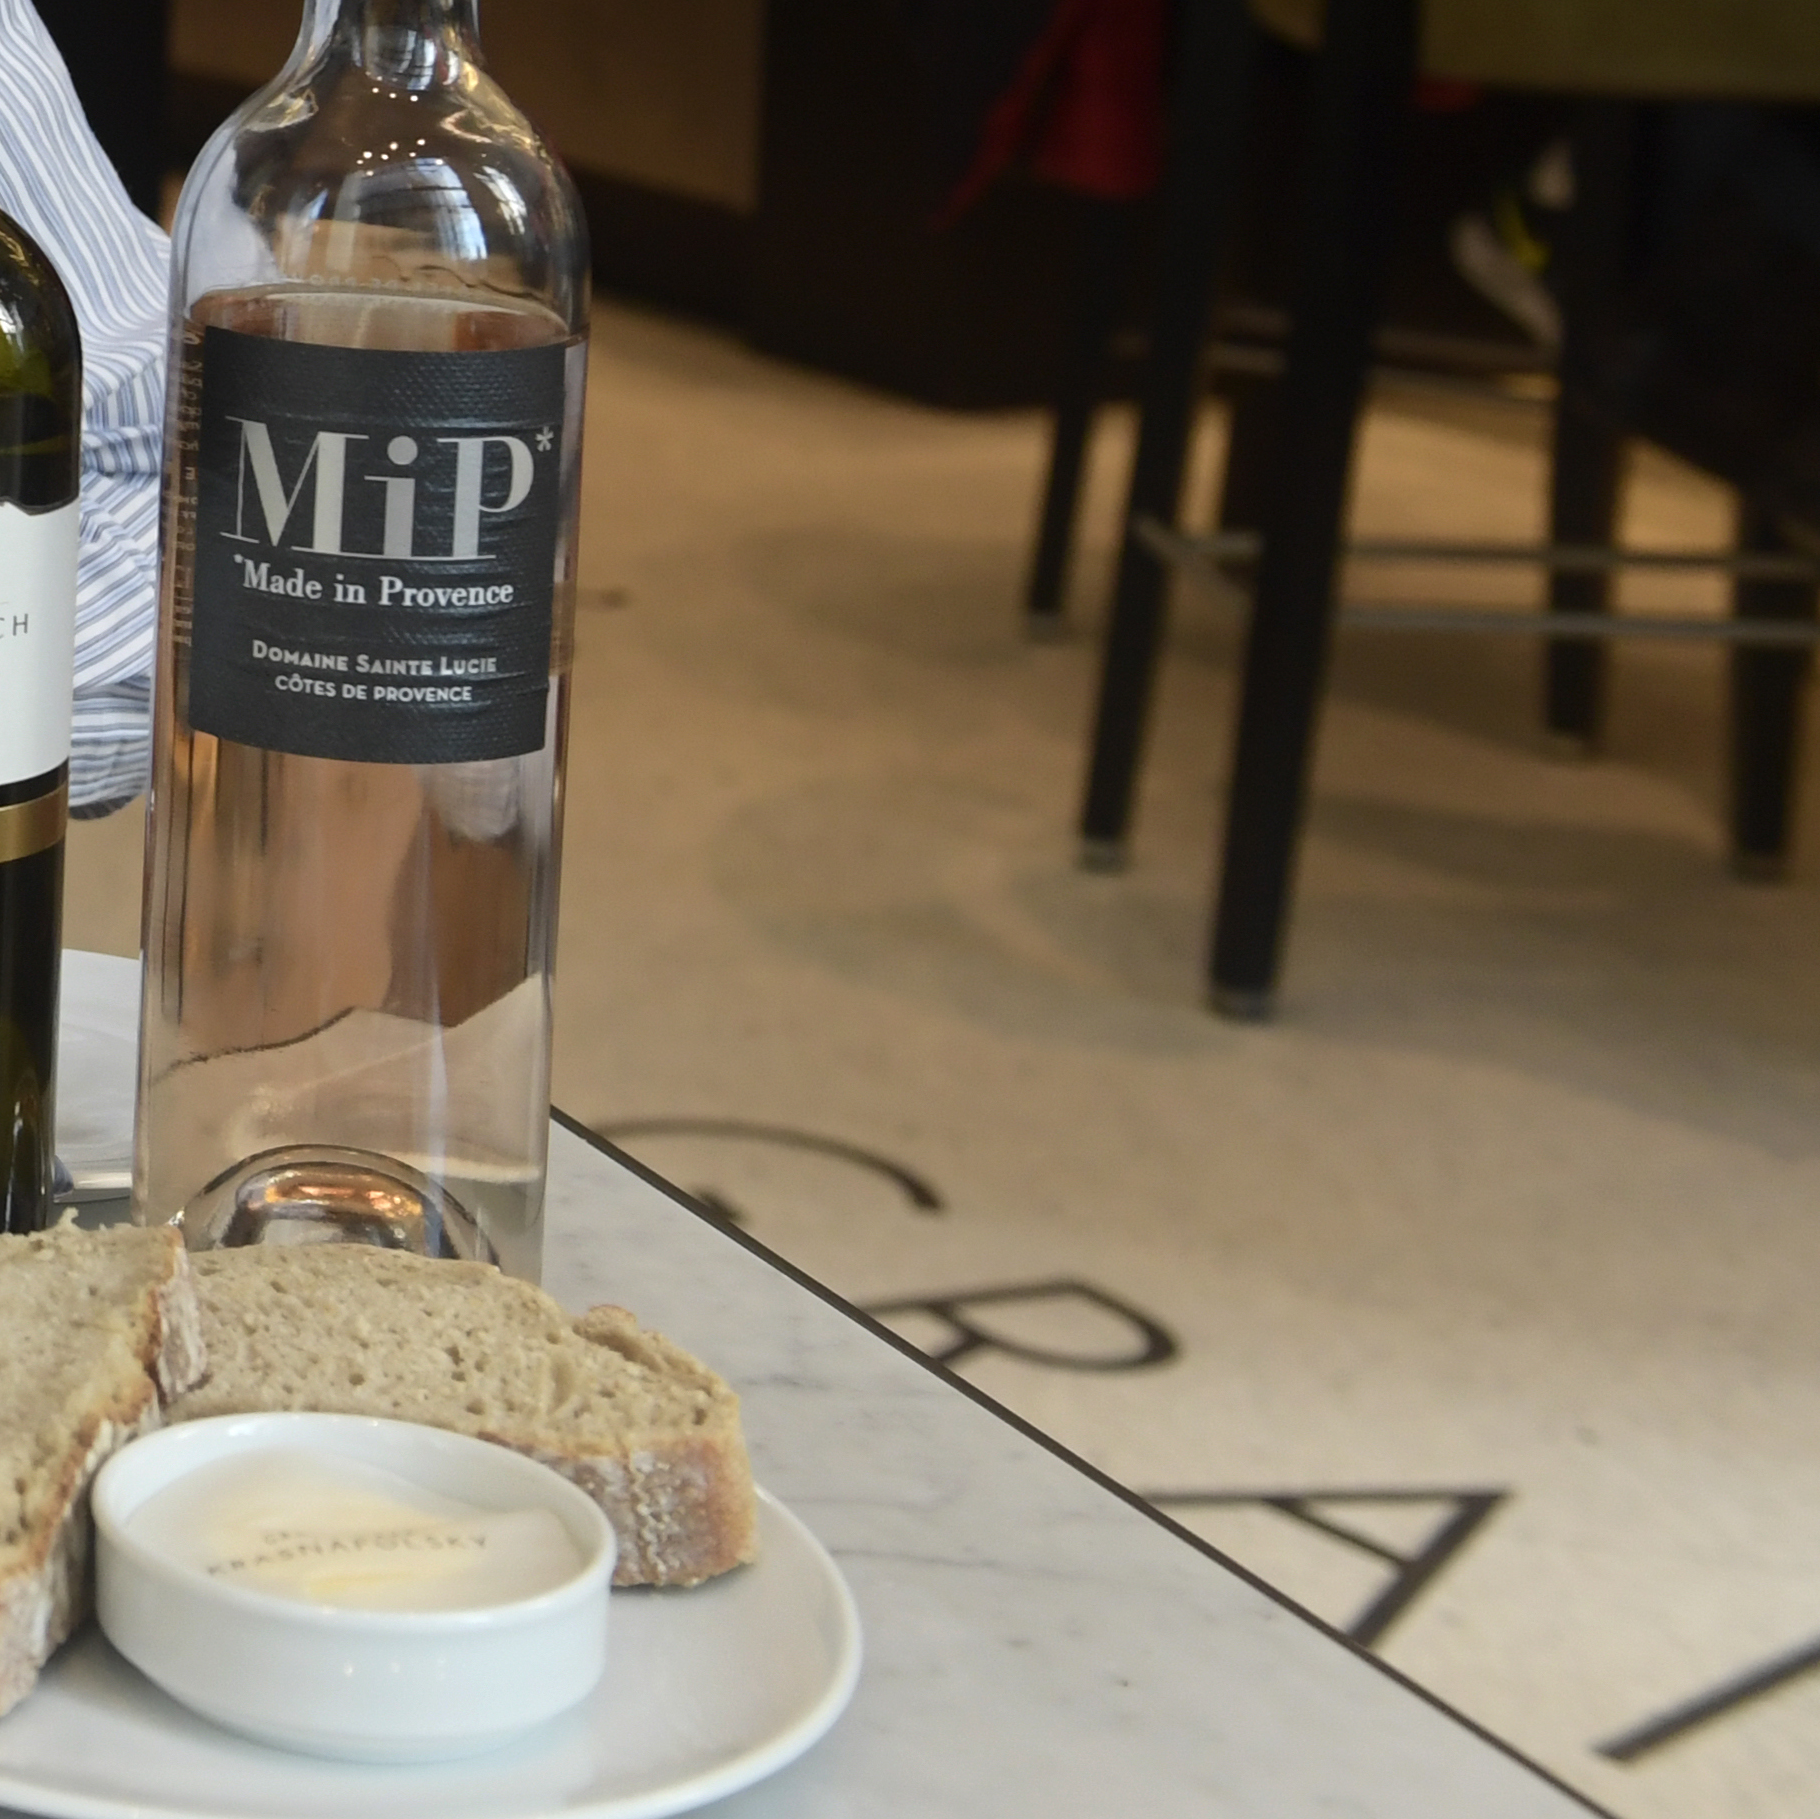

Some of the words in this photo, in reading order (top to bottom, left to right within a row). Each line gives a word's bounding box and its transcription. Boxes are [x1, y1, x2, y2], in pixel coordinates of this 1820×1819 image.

[334, 574, 366, 604] in
[379, 575, 514, 607] Provence
[252, 640, 349, 672] DOMAINE
[356, 654, 433, 675] SAINTE
[440, 656, 497, 675] LUCIE
[275, 673, 336, 698] CÔTES
[342, 684, 367, 699] DE
[374, 685, 472, 702] PROVENCE
